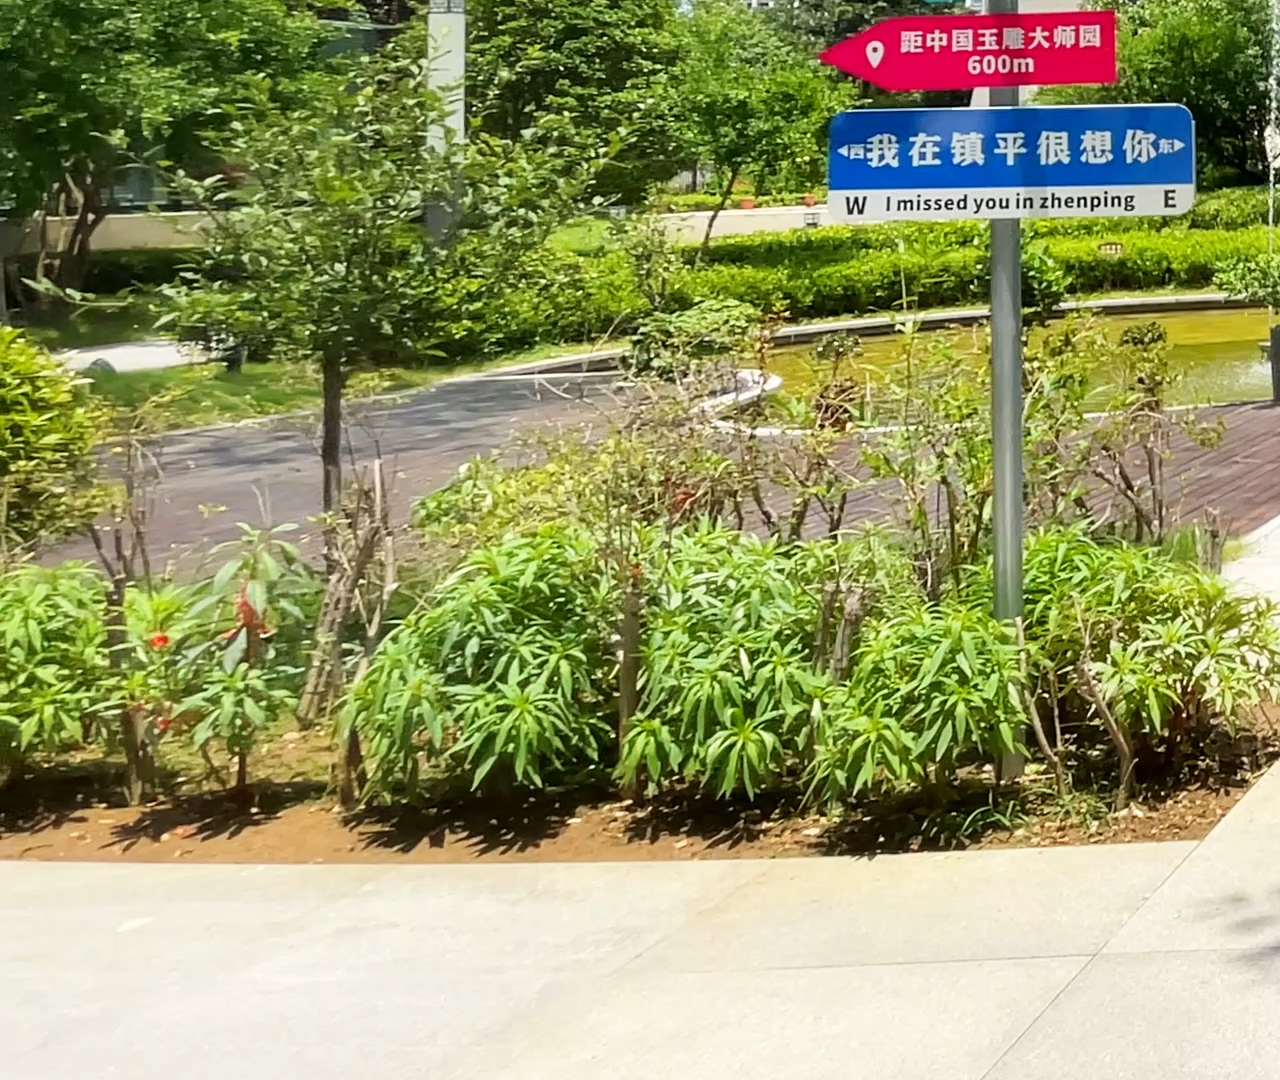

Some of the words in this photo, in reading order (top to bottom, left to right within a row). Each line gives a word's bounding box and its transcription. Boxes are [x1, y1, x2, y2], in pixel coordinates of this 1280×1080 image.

[900, 24, 1101, 54] 距中国玉雕大师园
[967, 54, 1035, 75] 600m
[866, 128, 1158, 168] 我在镇平很想你
[845, 196, 867, 215] W
[896, 194, 968, 212] missed
[973, 196, 1010, 214] you
[1016, 193, 1034, 210] in
[1039, 191, 1135, 212] zhenping
[1163, 189, 1177, 209] E
